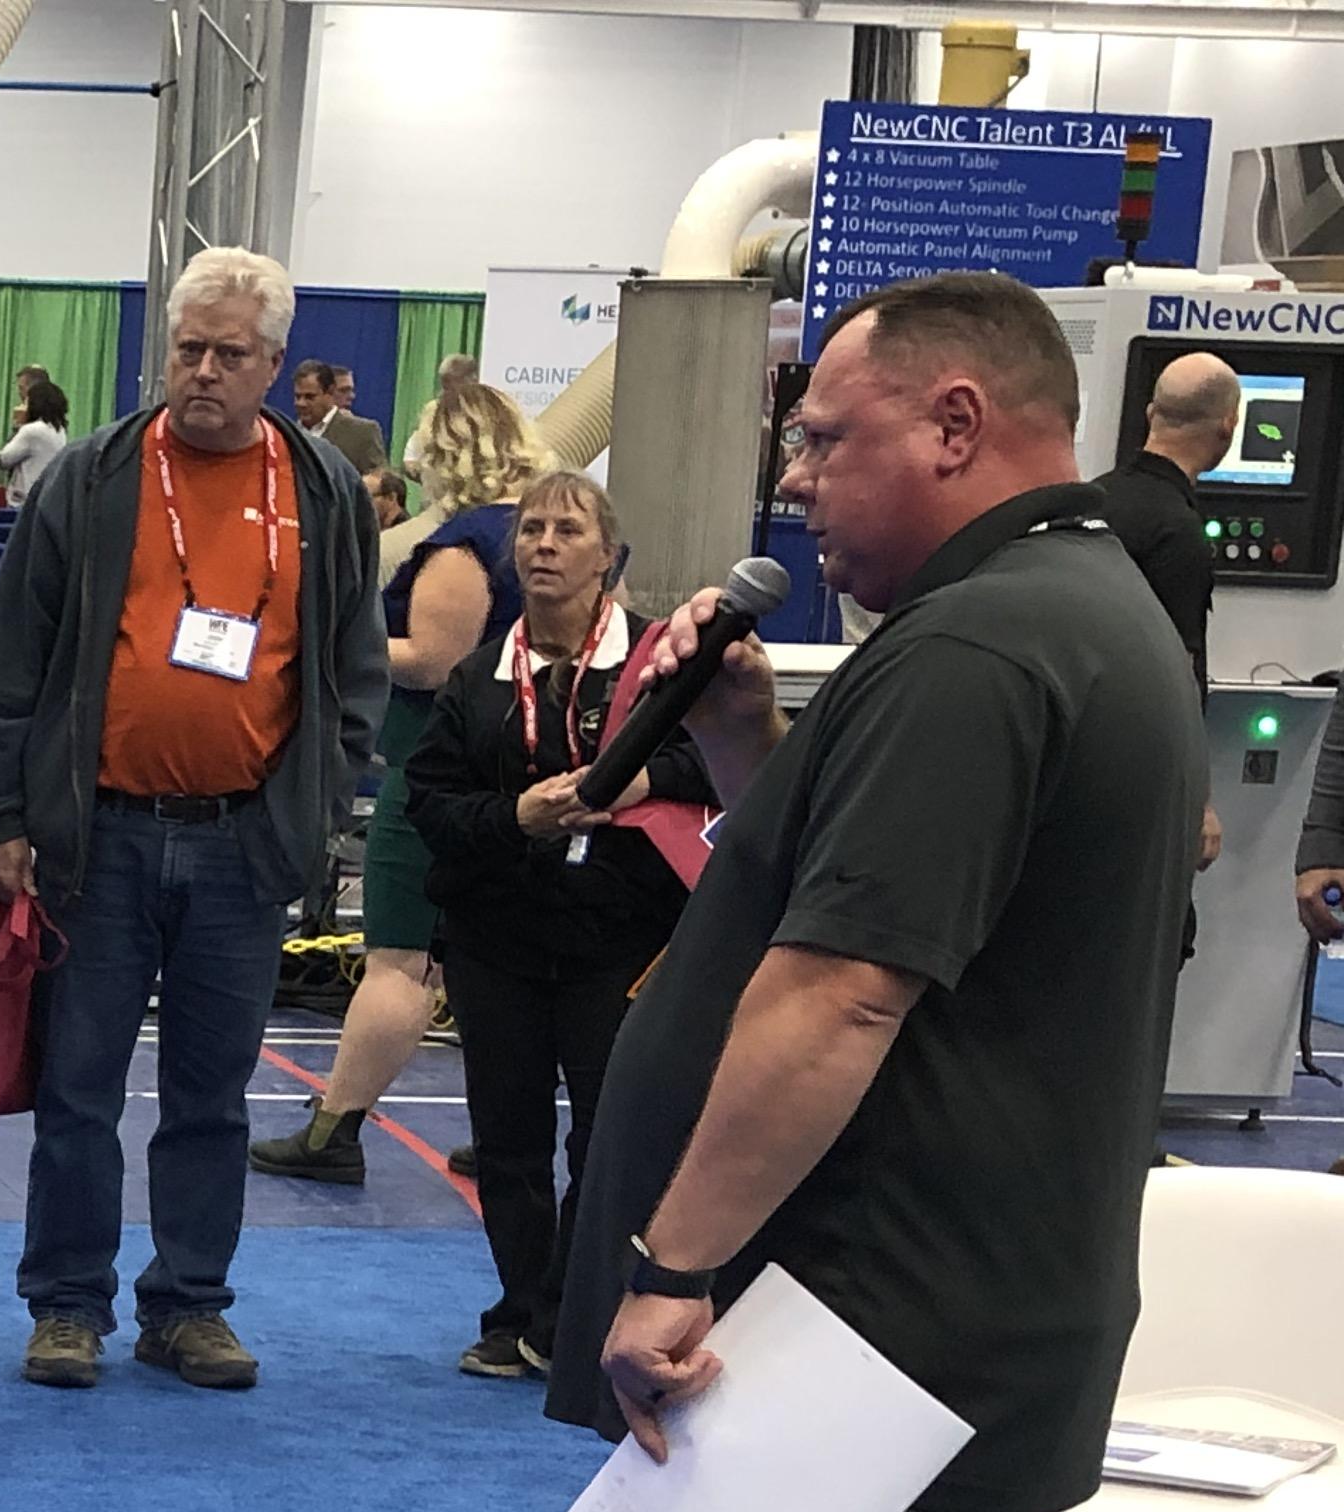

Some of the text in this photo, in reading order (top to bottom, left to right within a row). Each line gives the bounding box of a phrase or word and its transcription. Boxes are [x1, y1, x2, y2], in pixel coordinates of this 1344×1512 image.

[852, 112, 969, 140] NewCNC
[976, 116, 1054, 145] Talent
[1062, 121, 1093, 147] T3
[847, 149, 858, 162] 4
[875, 150, 885, 164] 8
[889, 151, 953, 167] Vacuum
[959, 152, 1000, 170] Table
[843, 171, 1027, 195] 12 Horsepower Spindle
[871, 196, 930, 214] Position
[938, 199, 1020, 218] Automatic
[1027, 203, 1057, 220] Tool
[841, 216, 1078, 245] 10 Horsepower Vacuum Pump
[837, 237, 1052, 263] Automatic Panel Alignment
[835, 260, 883, 277] DELTA
[888, 262, 933, 278] Servo
[596, 304, 617, 318] HE
[1185, 299, 1344, 335] NewCNC
[504, 366, 585, 384] CABINE
